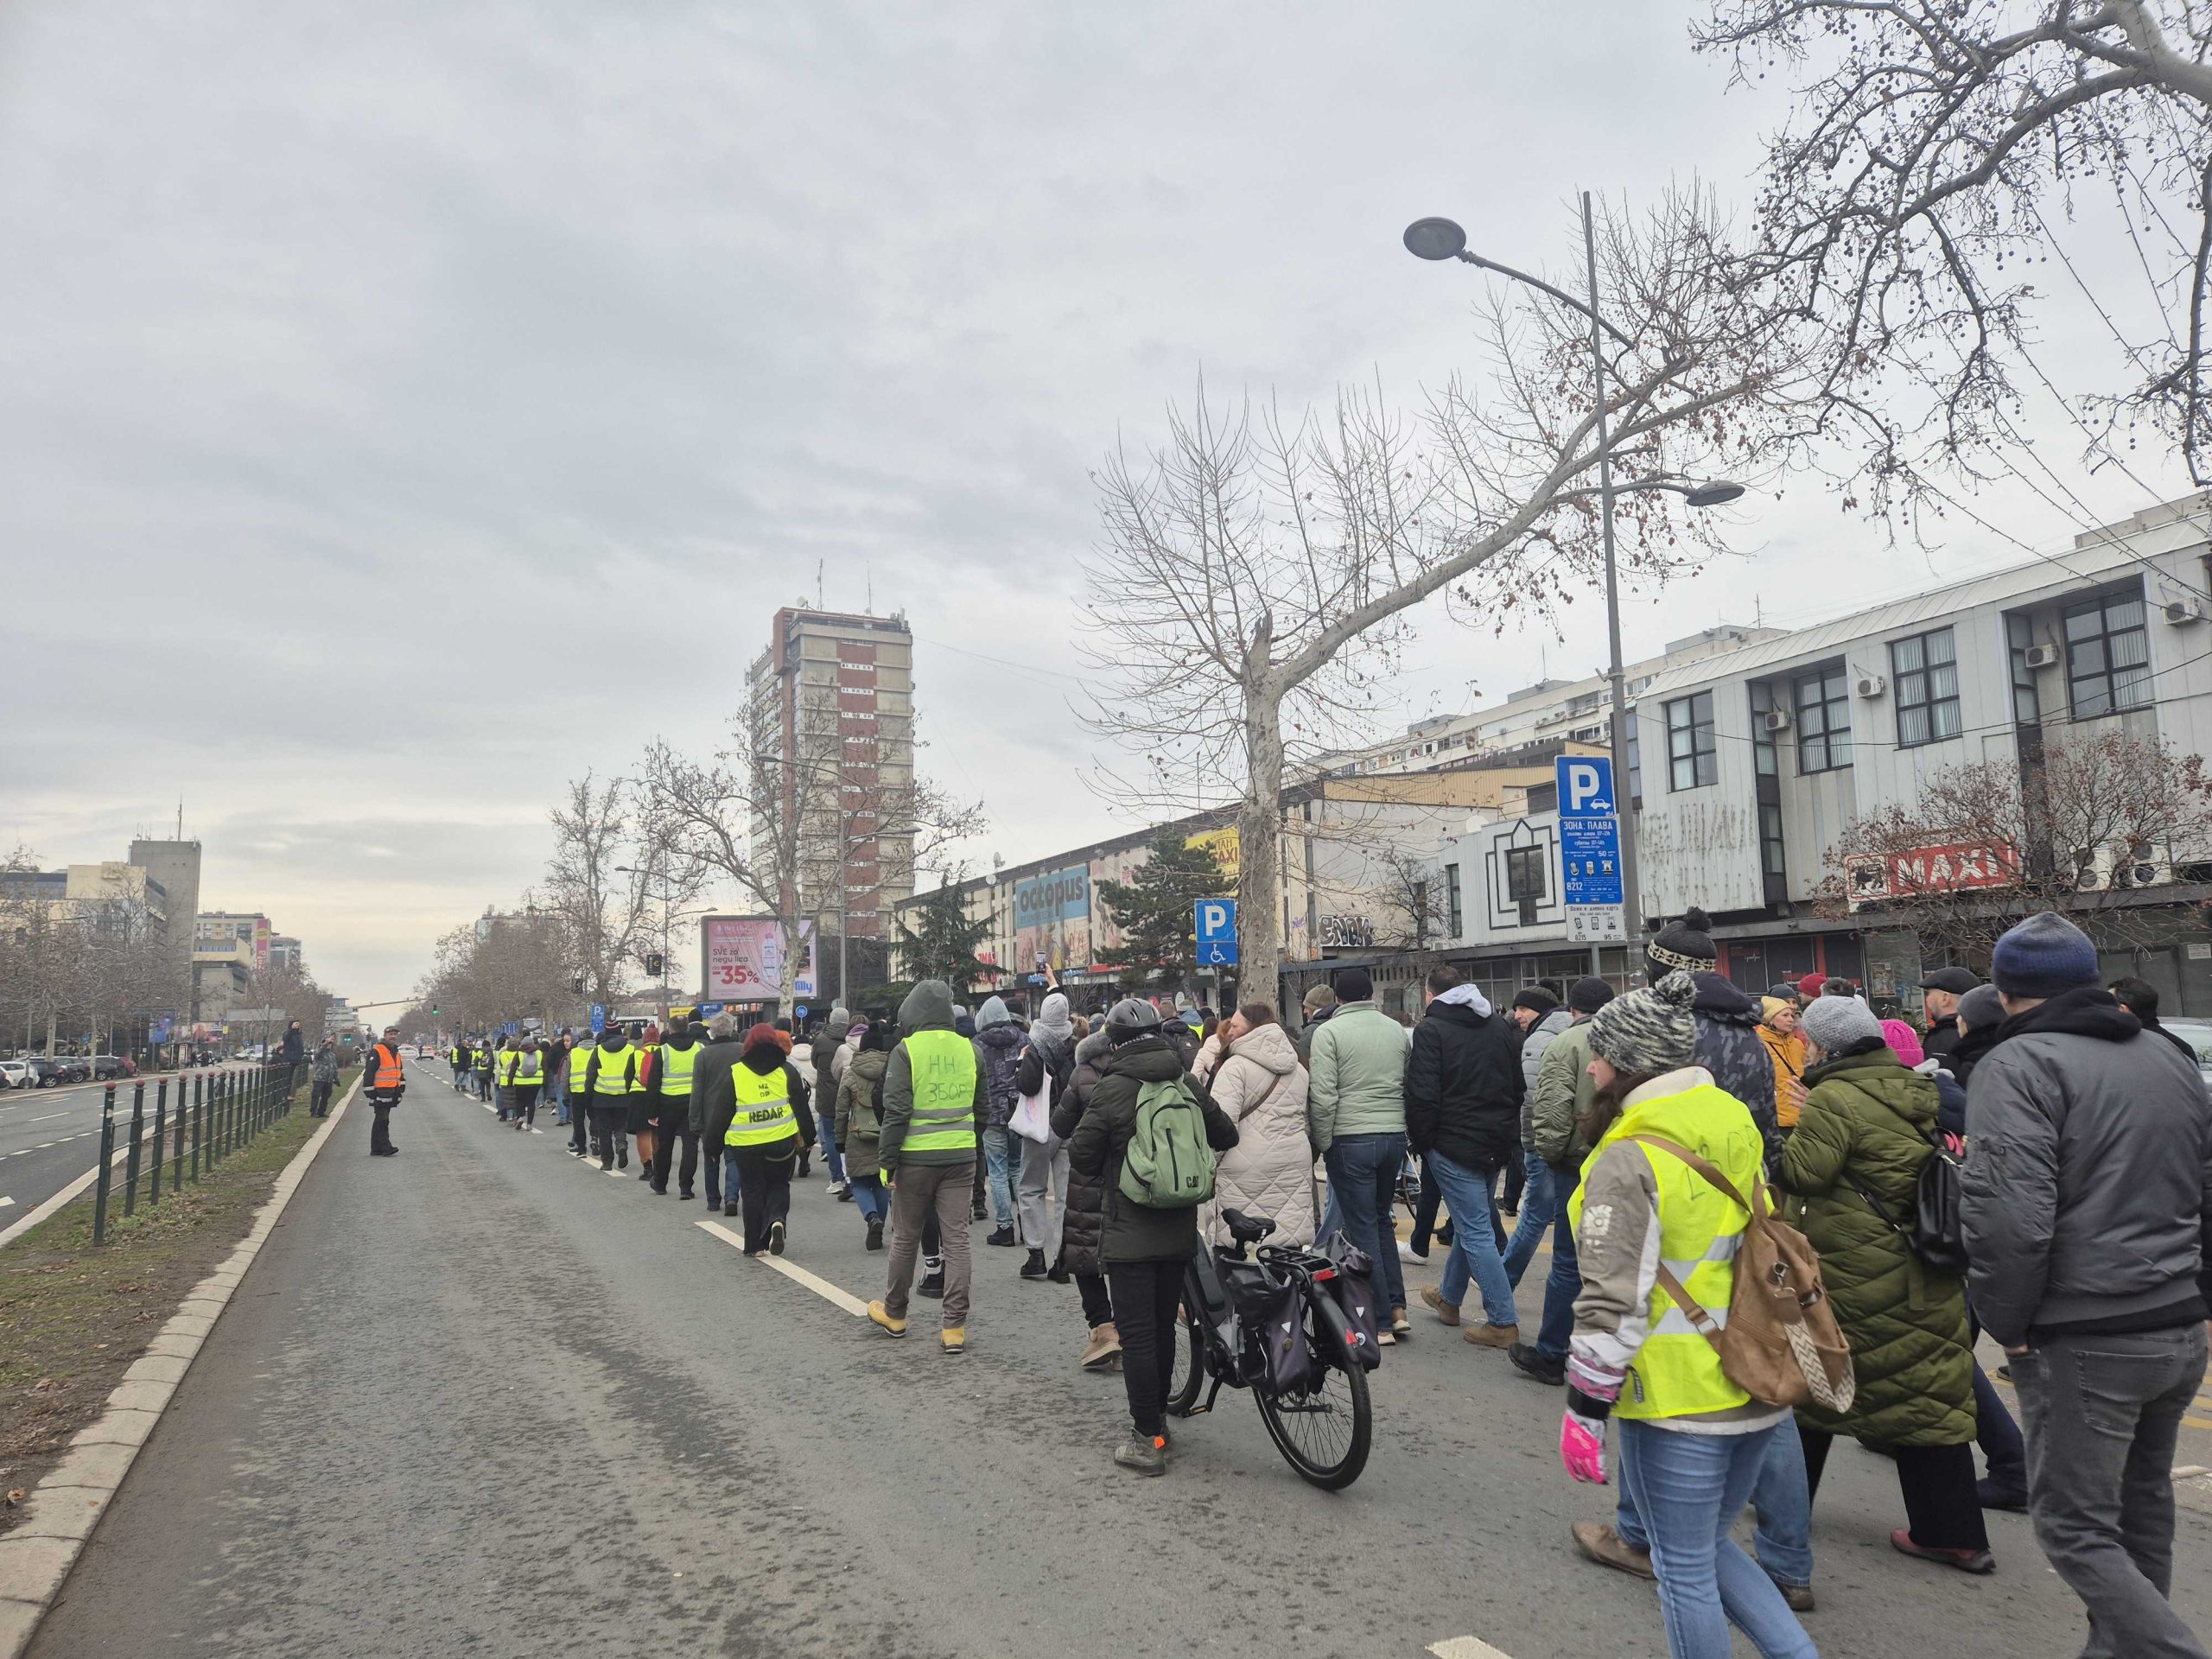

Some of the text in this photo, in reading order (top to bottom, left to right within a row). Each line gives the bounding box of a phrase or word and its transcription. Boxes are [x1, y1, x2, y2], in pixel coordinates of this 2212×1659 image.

[1569, 765, 1599, 810] P
[1563, 821, 1613, 830] ЗОНА: ПЛАВА
[1897, 848, 1999, 887] MAXI
[1020, 875, 1084, 916] octopus
[1567, 881, 1583, 891] 8212
[1205, 906, 1226, 937] P
[748, 1107, 784, 1123] REDAR
[1185, 1175, 1198, 1188] CAT
